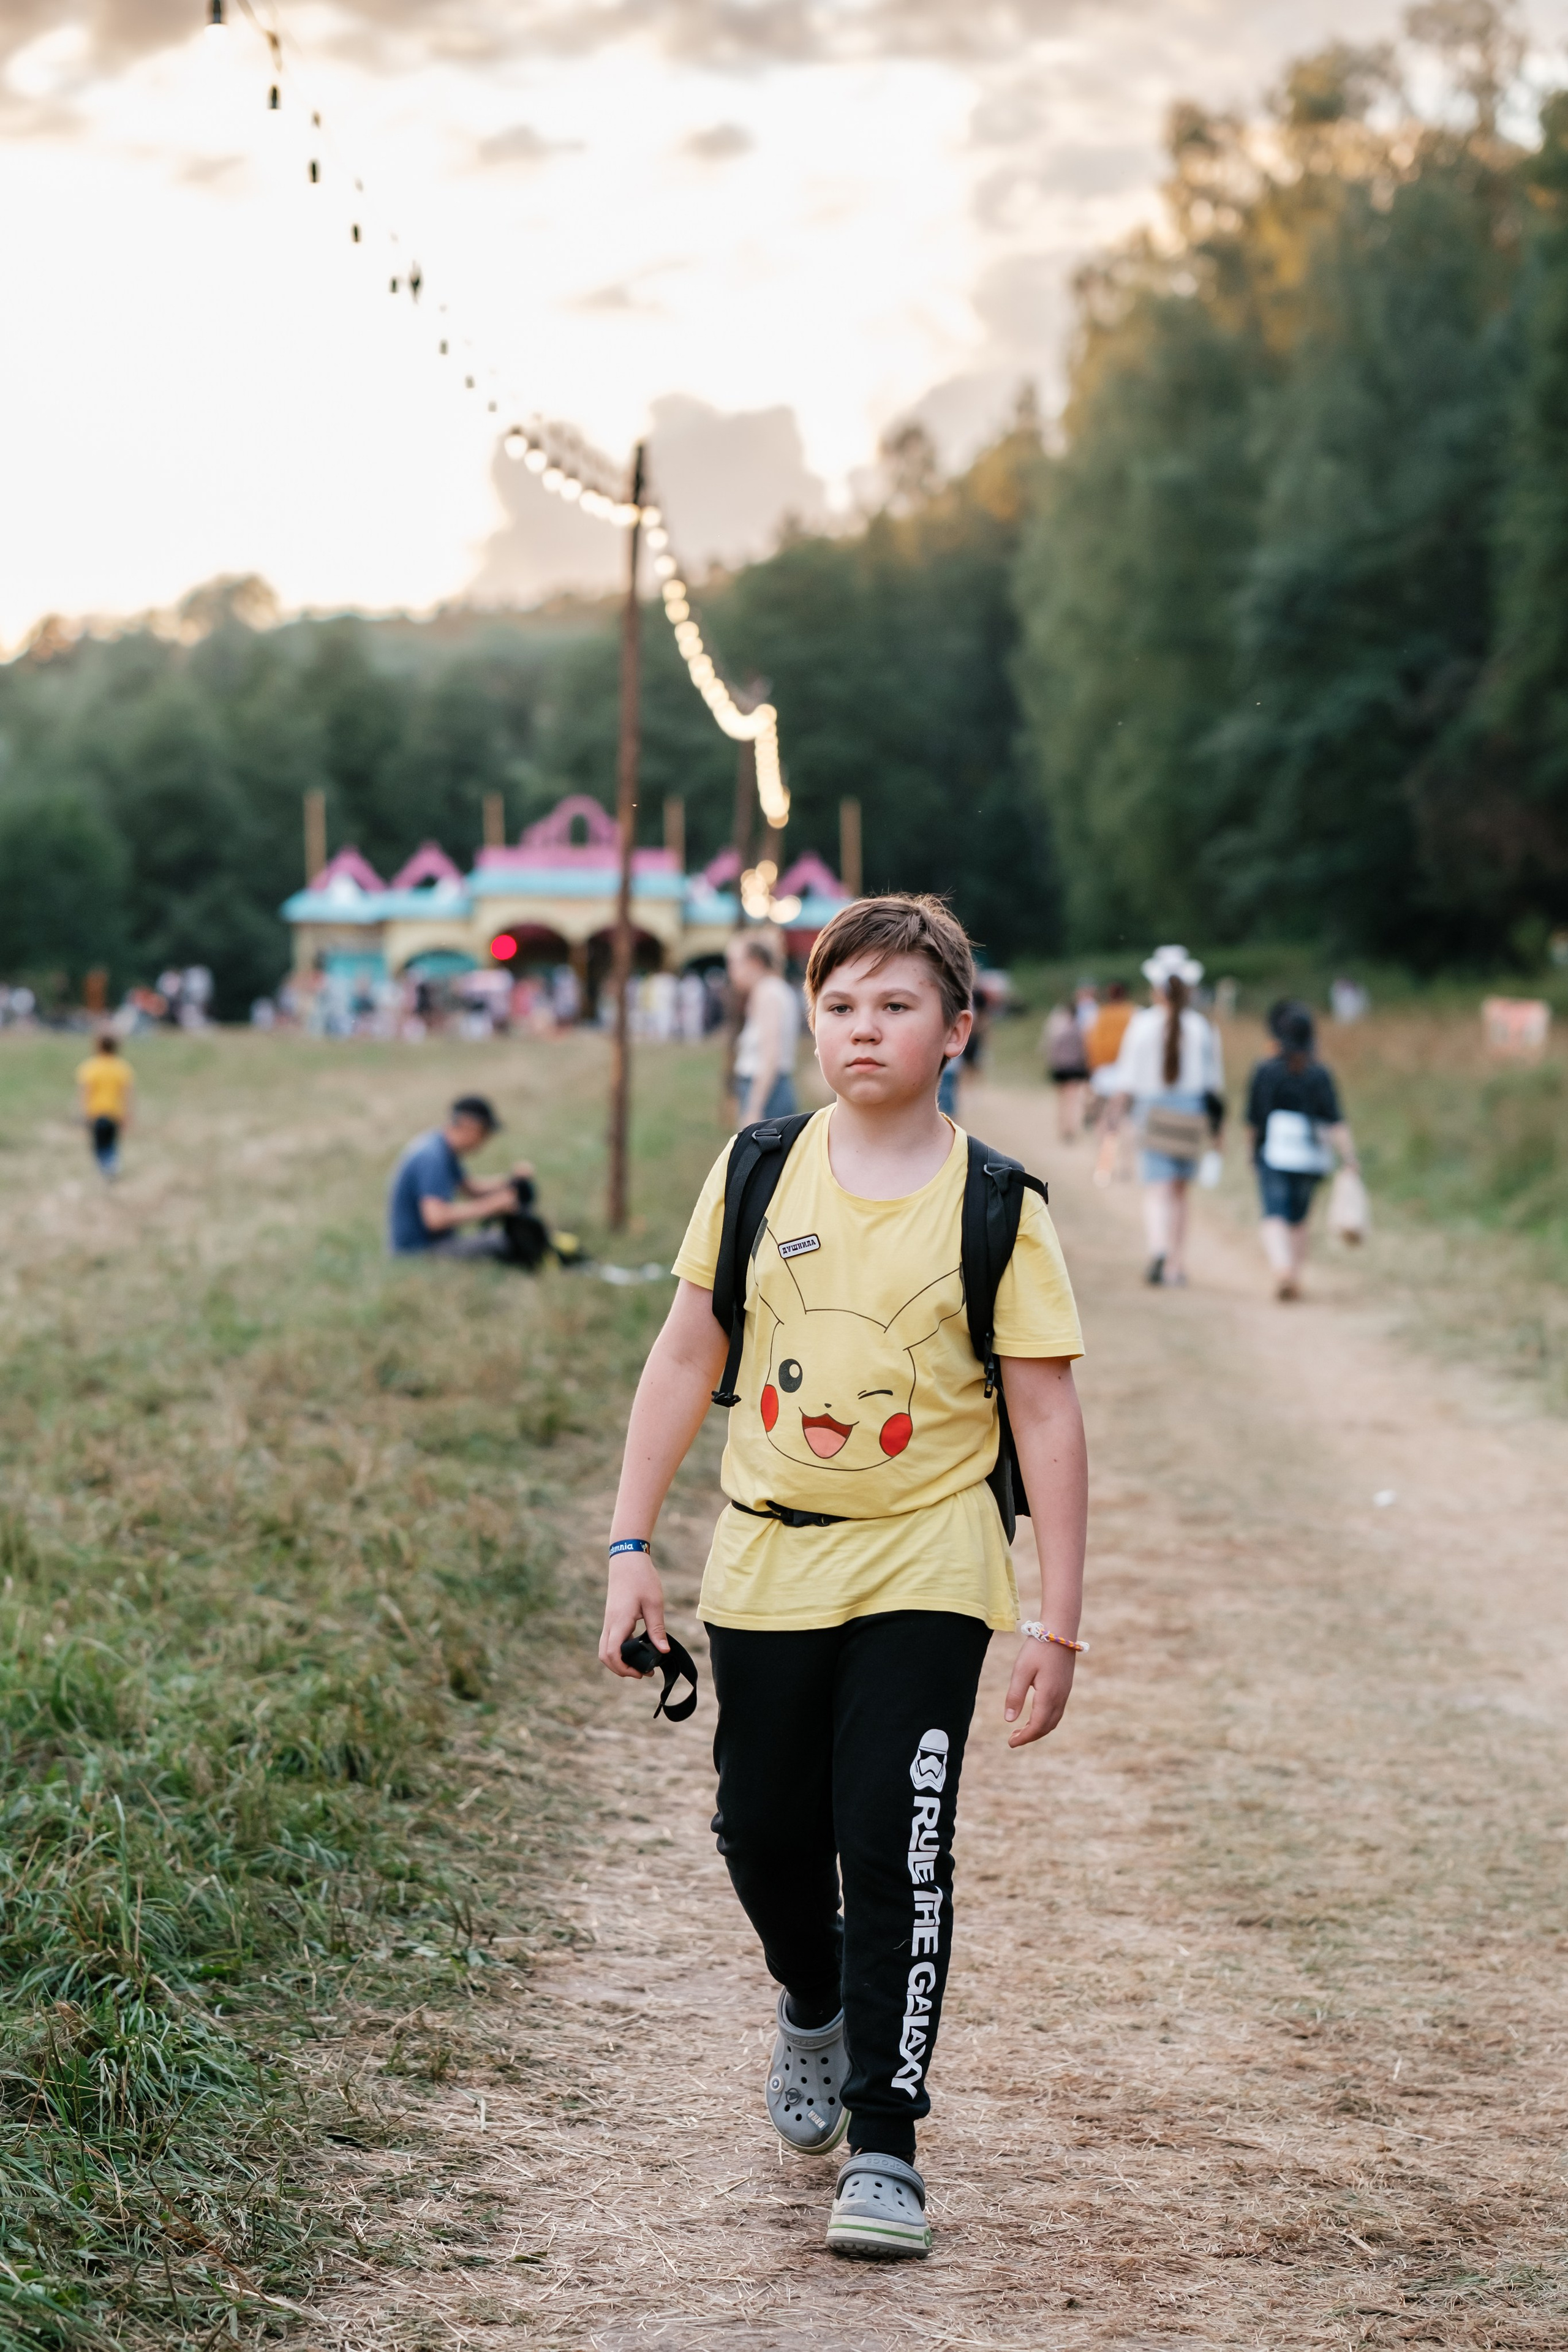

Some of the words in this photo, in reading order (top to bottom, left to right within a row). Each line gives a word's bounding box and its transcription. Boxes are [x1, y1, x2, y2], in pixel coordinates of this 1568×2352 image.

[782, 1239, 816, 1254] ДУШНИЛА
[908, 1796, 941, 1885] RULE
[911, 1885, 943, 1956] THE
[891, 1961, 936, 2100] GALAXY
[866, 2158, 902, 2169] crocs
